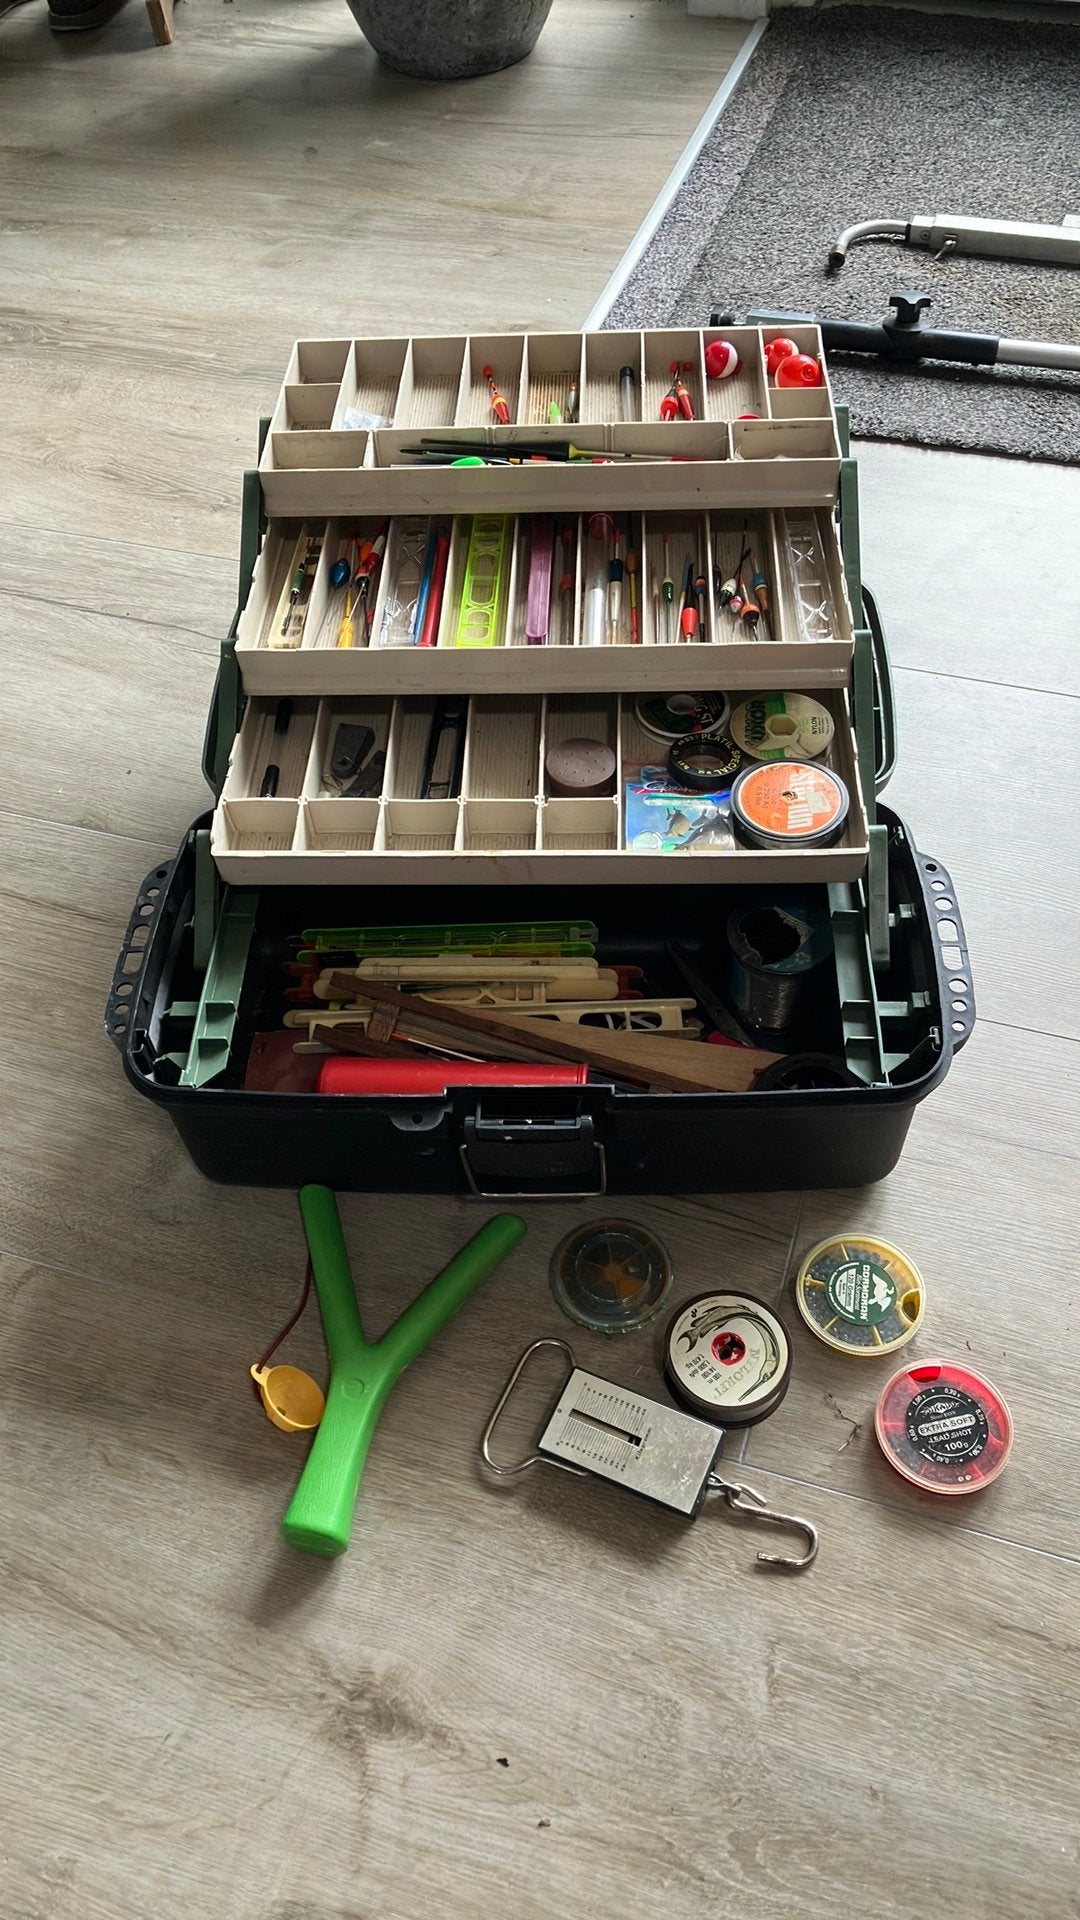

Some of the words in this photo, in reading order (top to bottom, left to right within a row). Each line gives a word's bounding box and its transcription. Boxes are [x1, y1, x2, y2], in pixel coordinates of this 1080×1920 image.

[714, 750, 741, 775] SPECIAL
[846, 1286, 854, 1306] Gramm
[860, 1265, 870, 1319] CORMORAN
[713, 1372, 722, 1381] 100
[920, 1422, 949, 1434] EXTRA
[950, 1416, 973, 1426] SOFT
[929, 1433, 950, 1443] LEAD
[951, 1429, 972, 1438] SHOT
[945, 1441, 962, 1451] 100
